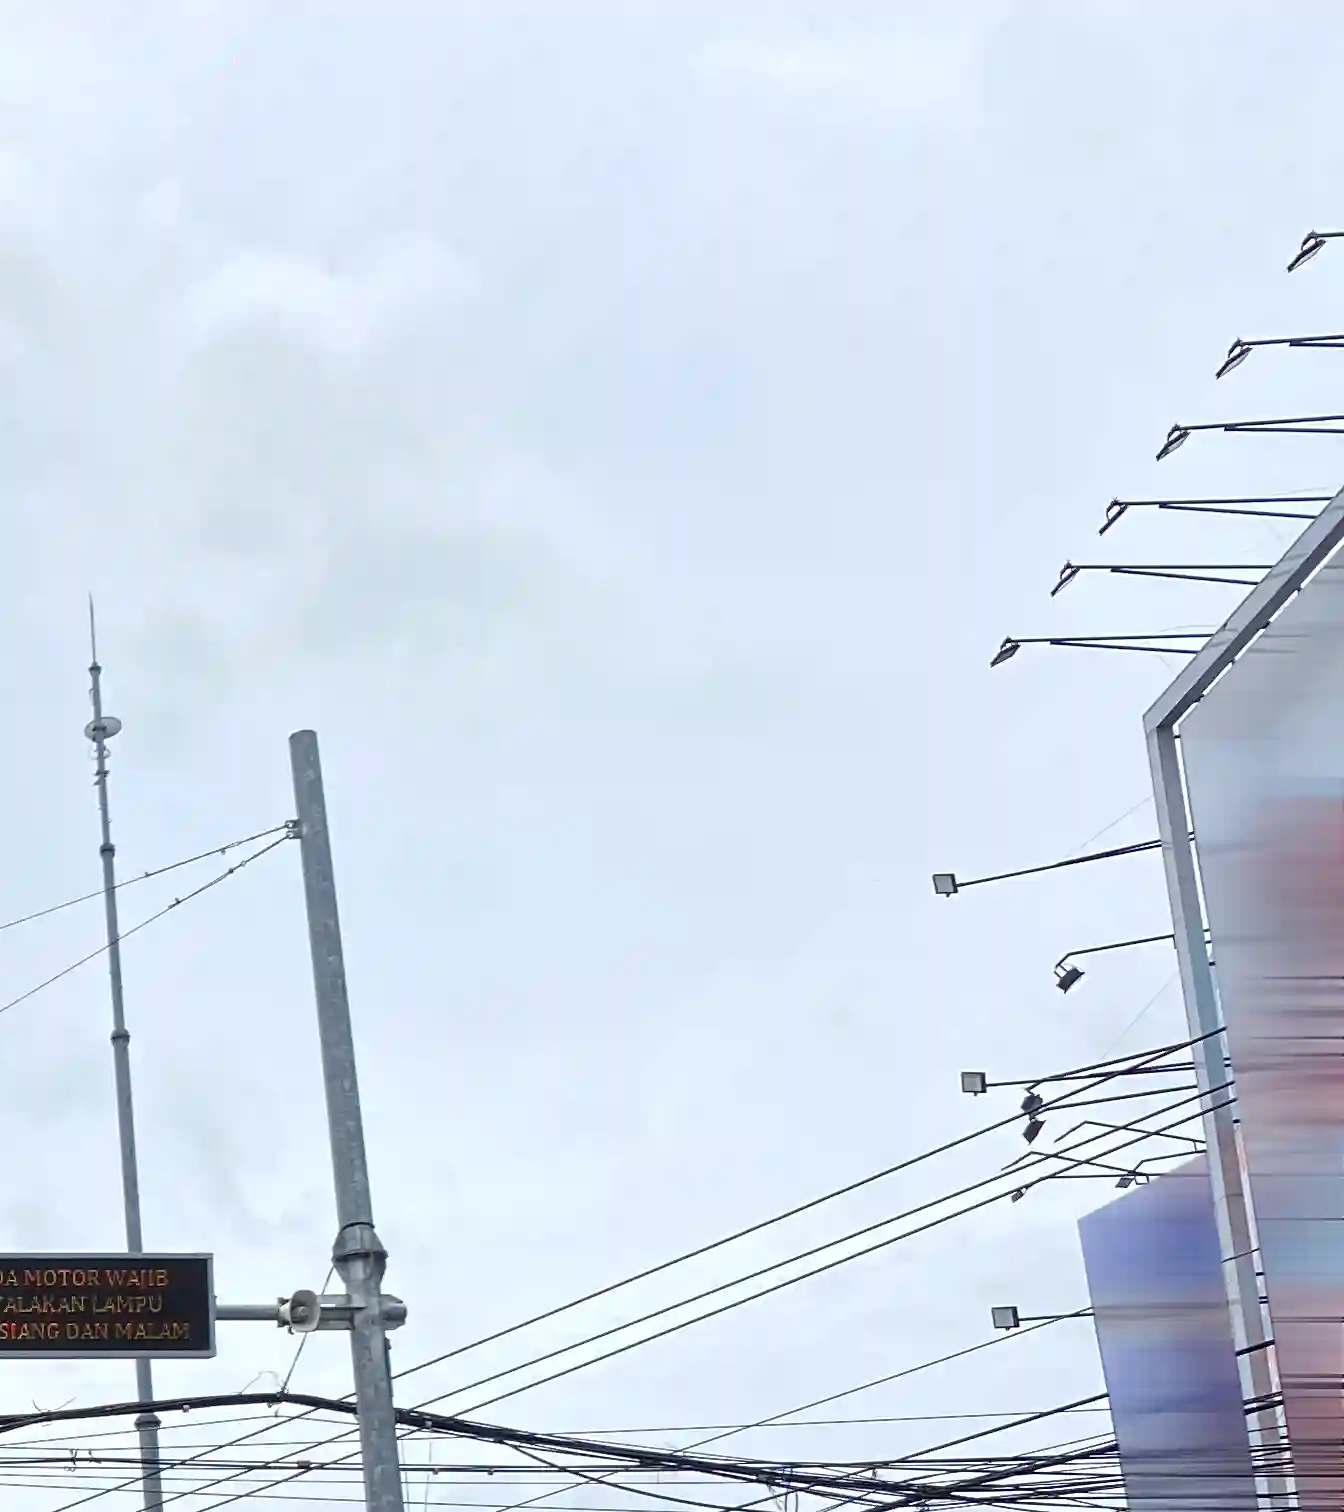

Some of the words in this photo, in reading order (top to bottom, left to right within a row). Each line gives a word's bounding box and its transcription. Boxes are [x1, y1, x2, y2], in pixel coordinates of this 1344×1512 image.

[23, 1269, 101, 1287] MOTOR
[106, 1269, 169, 1287] WAJIB
[93, 1295, 162, 1313] LAMPU
[0, 1322, 61, 1341] SIANG
[67, 1322, 109, 1341] DAN
[115, 1322, 192, 1341] MALAM
